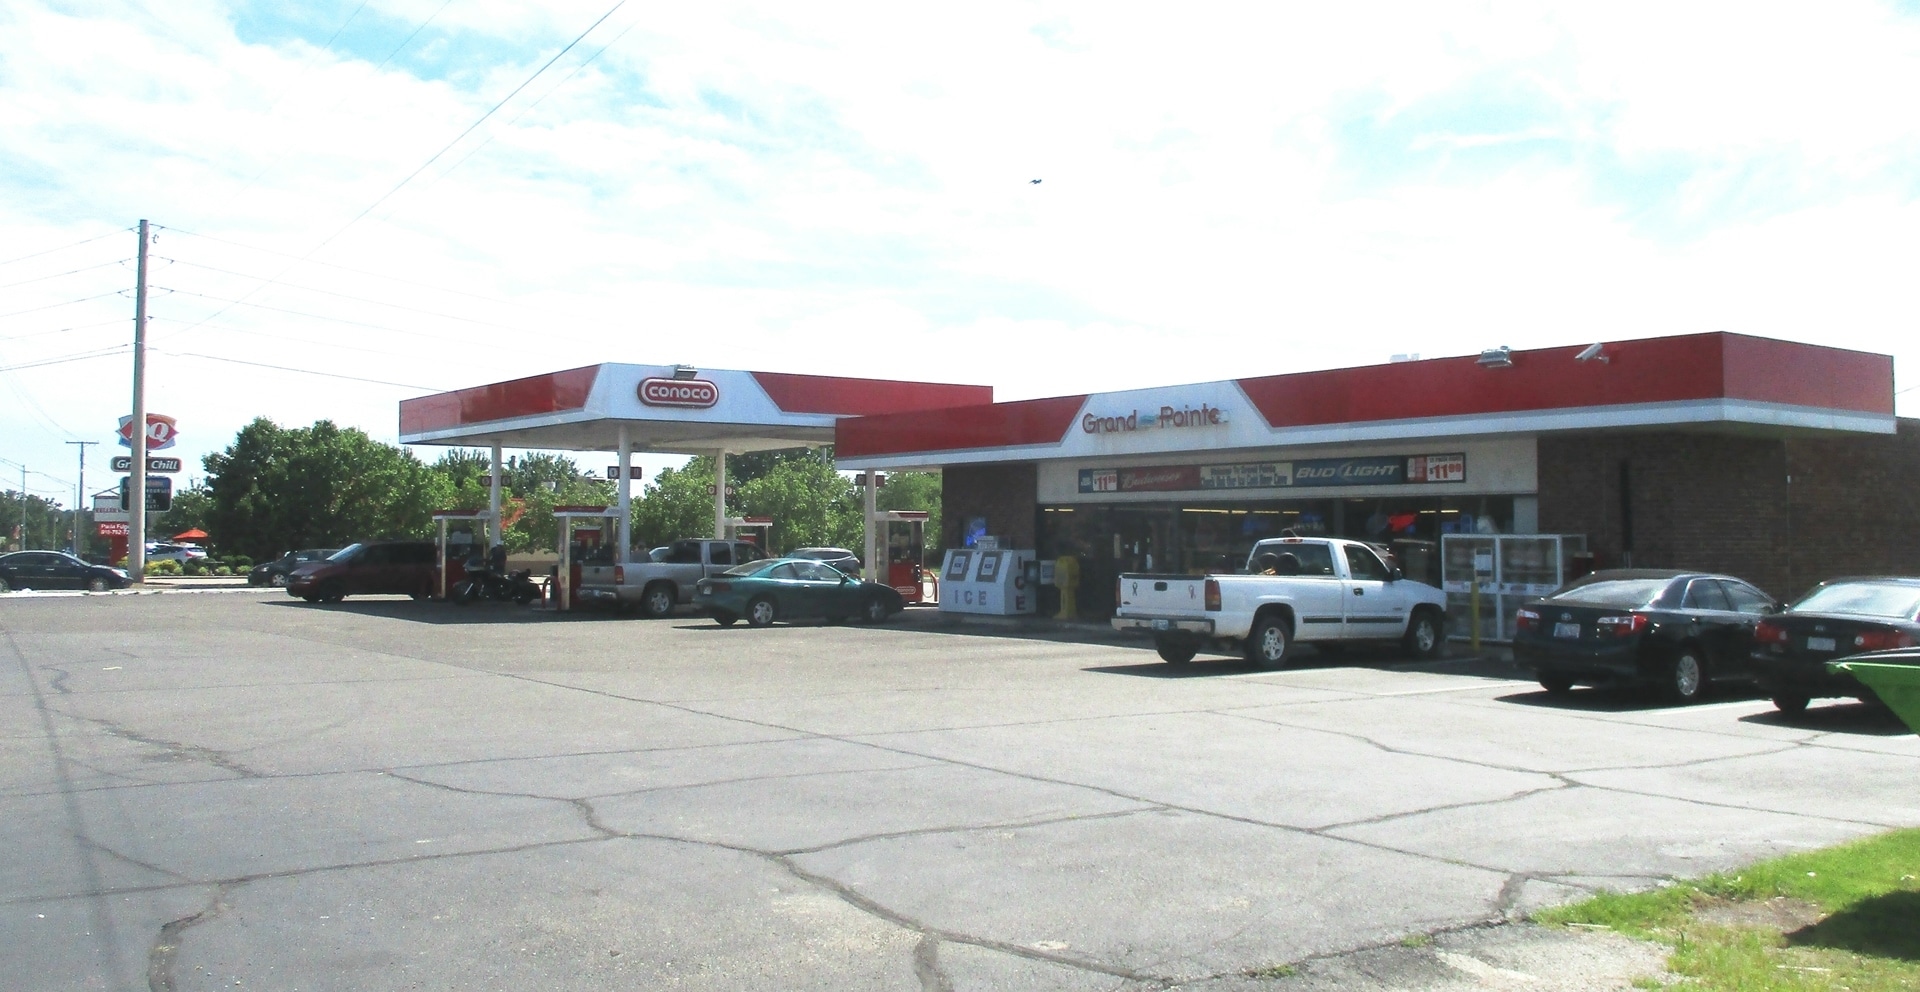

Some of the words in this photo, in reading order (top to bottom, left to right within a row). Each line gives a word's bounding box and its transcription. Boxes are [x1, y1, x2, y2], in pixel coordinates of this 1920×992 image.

[648, 386, 712, 400] conoco
[1082, 409, 1137, 434] Grand
[151, 460, 177, 470] Chill
[1296, 467, 1336, 479] BUD
[1344, 464, 1399, 478] LIGHT
[1015, 555, 1026, 611] ICE
[954, 589, 987, 606] ICE
